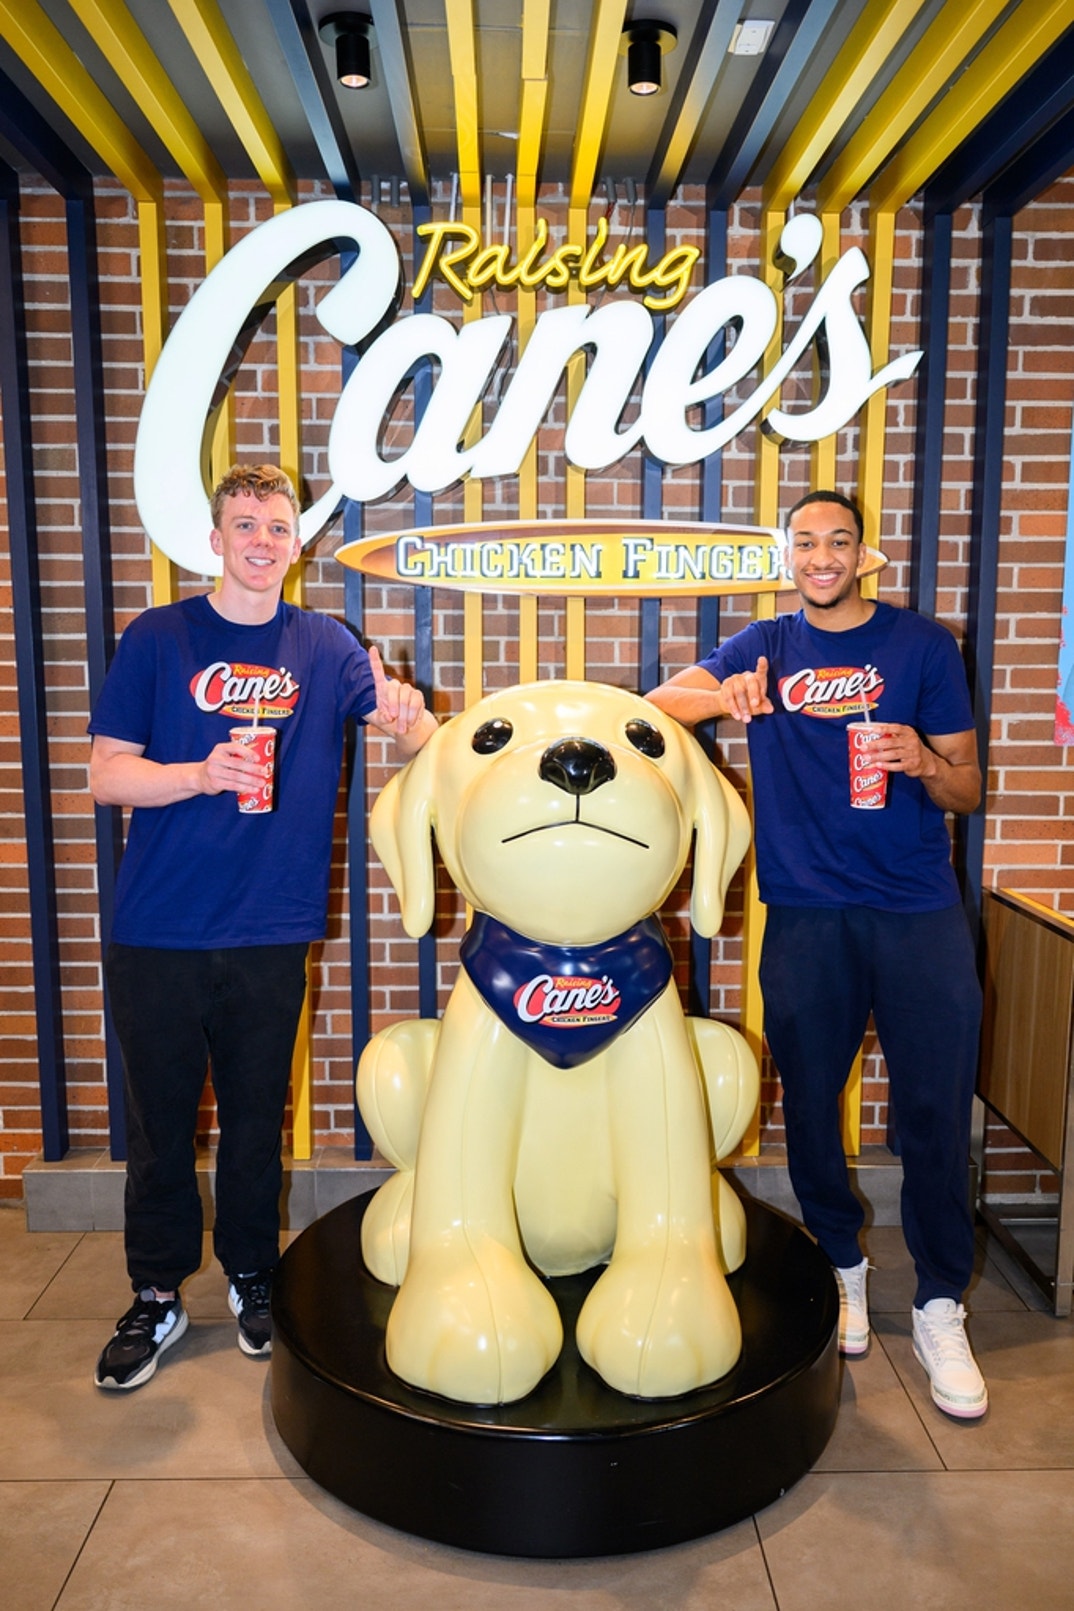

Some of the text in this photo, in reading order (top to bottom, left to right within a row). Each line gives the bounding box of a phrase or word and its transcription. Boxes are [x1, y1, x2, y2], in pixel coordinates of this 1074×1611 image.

[410, 217, 701, 310] Raising
[134, 199, 924, 577] Cane's
[396, 535, 604, 580] CHICKEN
[195, 661, 299, 712] Cane's
[233, 664, 270, 678] Raising
[782, 663, 884, 712] Cane's
[817, 668, 853, 680] Raising
[517, 974, 620, 1022] Cane's
[555, 979, 592, 989] Raising
